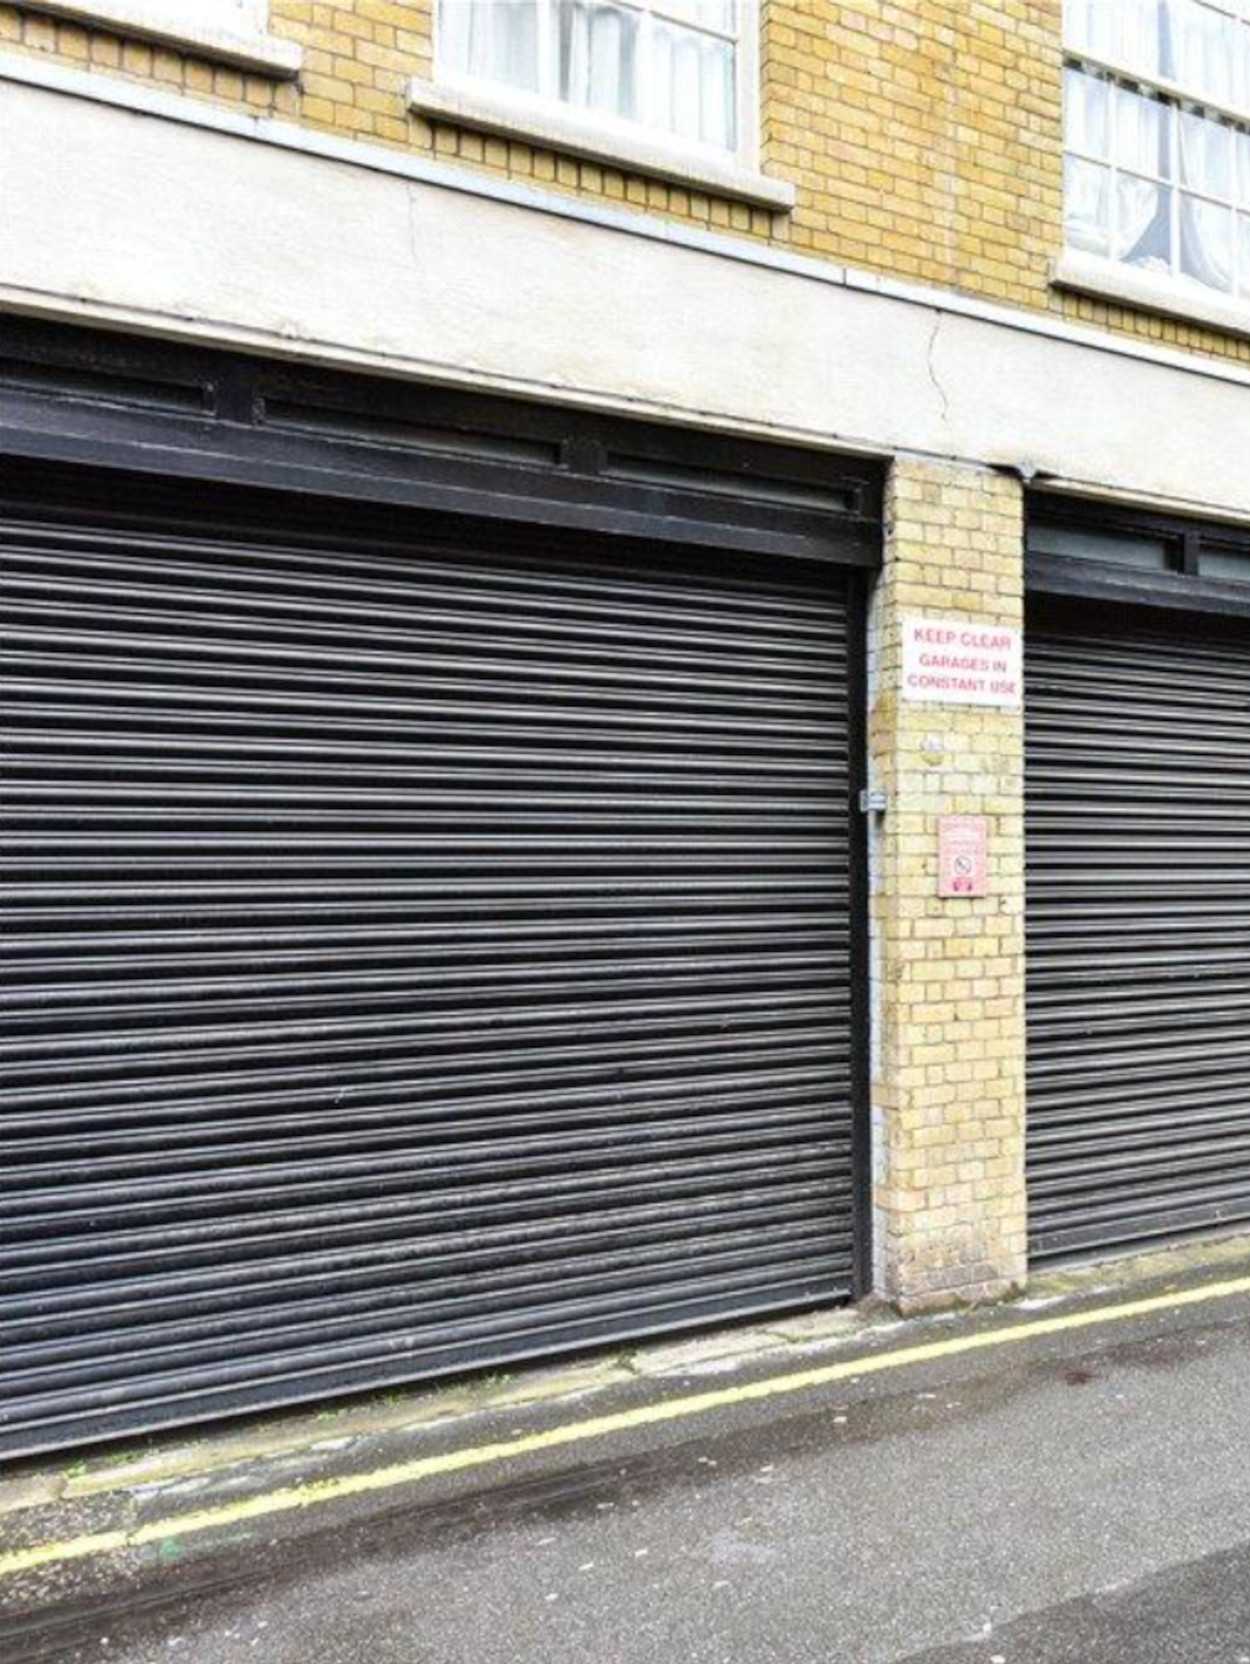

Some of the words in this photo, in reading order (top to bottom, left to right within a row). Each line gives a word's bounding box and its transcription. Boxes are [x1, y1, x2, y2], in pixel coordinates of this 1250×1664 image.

[914, 628, 956, 645] KEEP
[960, 631, 1012, 650] CLEAR
[919, 653, 989, 672] GARAGES
[992, 660, 1007, 673] IN
[907, 674, 985, 692] CONSTANT
[990, 680, 1016, 695] USE
